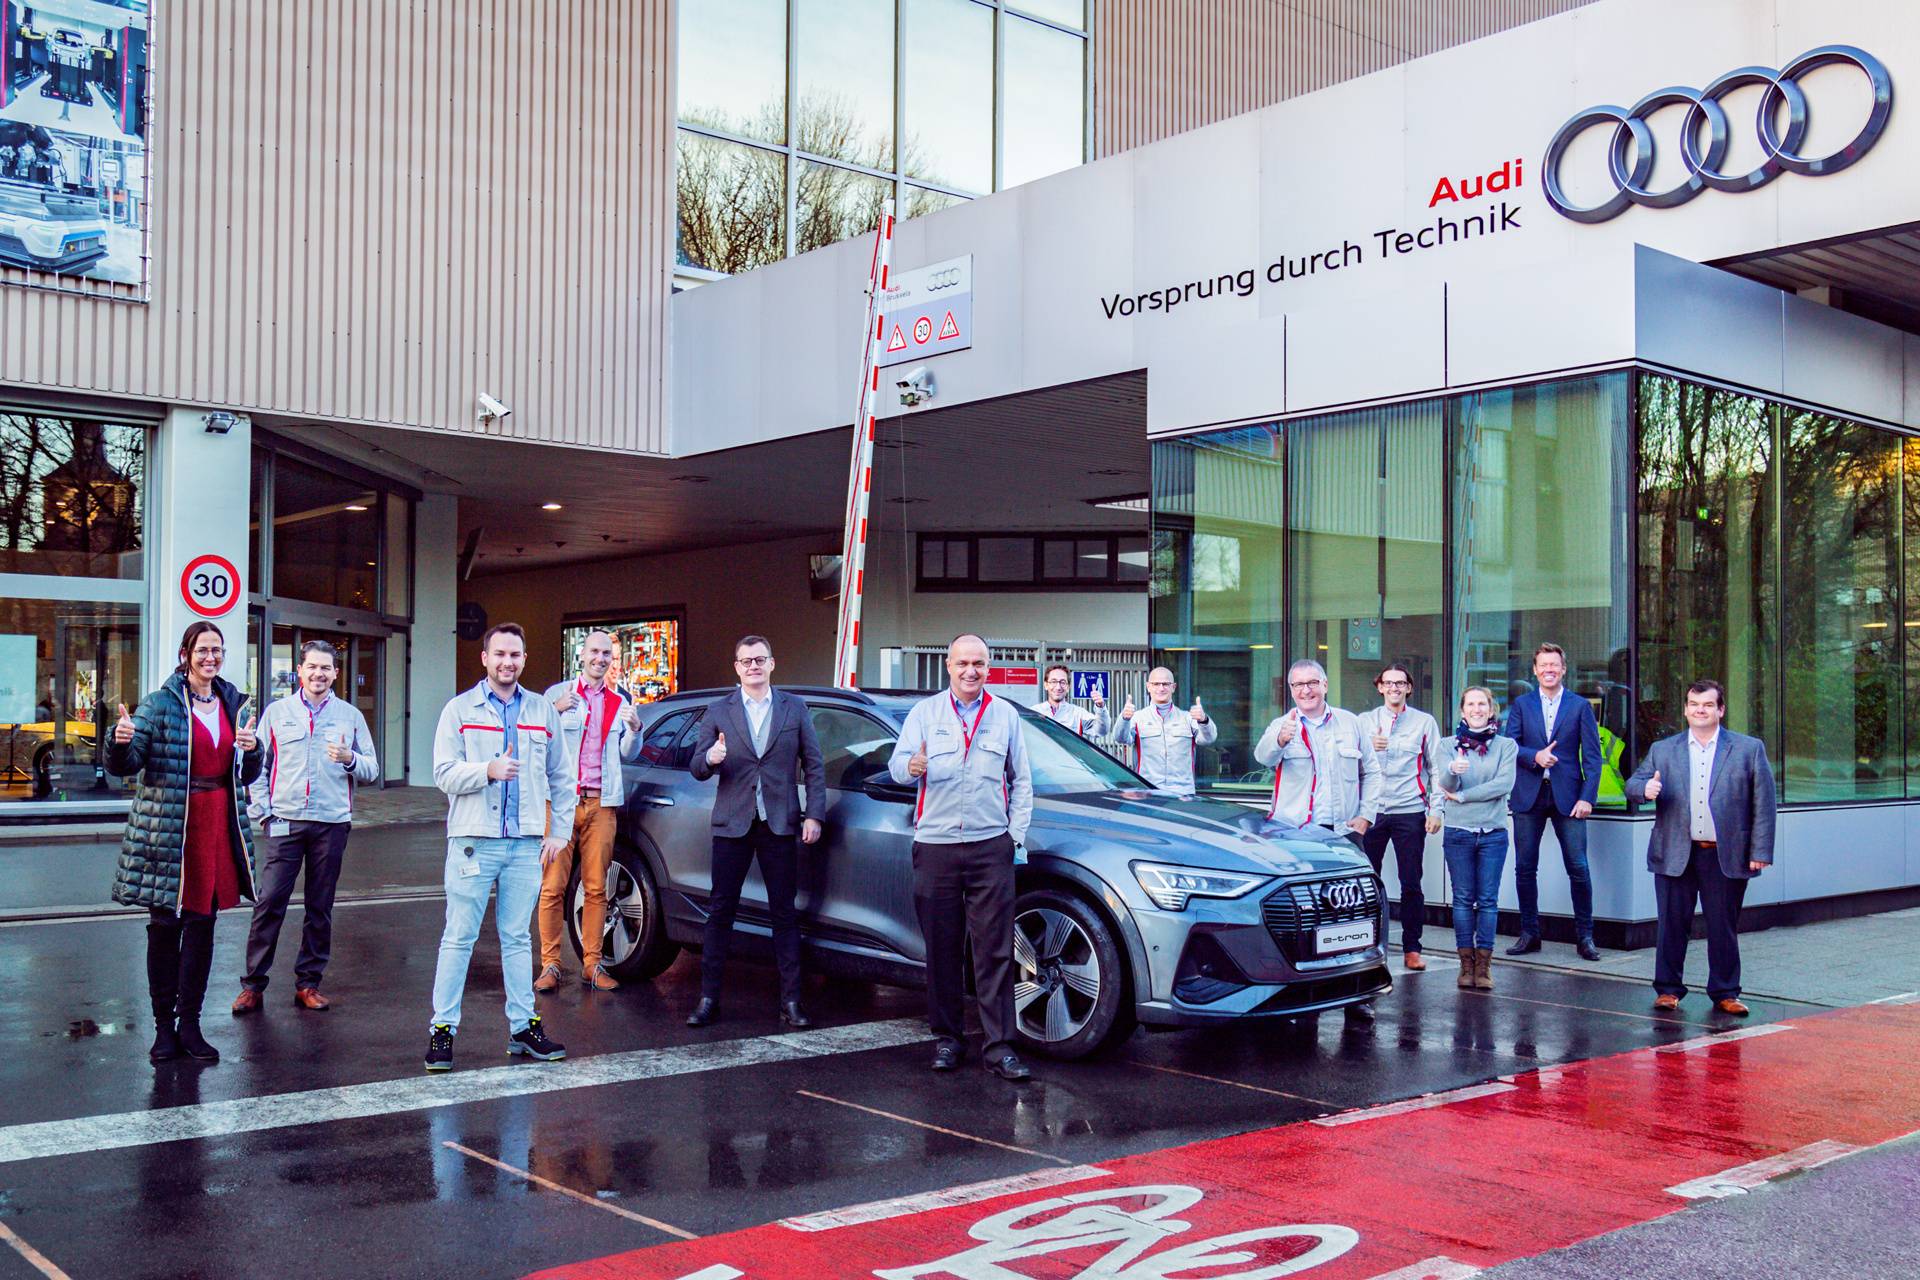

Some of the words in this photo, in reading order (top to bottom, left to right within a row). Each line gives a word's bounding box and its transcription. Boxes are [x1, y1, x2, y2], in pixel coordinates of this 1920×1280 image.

[1428, 158, 1523, 208] Audi
[1101, 269, 1255, 319] Vorsprung
[1267, 240, 1362, 283] durch
[1373, 202, 1522, 258] Technik
[886, 284, 901, 293] Audi
[886, 290, 911, 302] Brussels
[917, 323, 928, 337] 30
[193, 573, 228, 598] 30
[1323, 932, 1369, 944] e-tron
